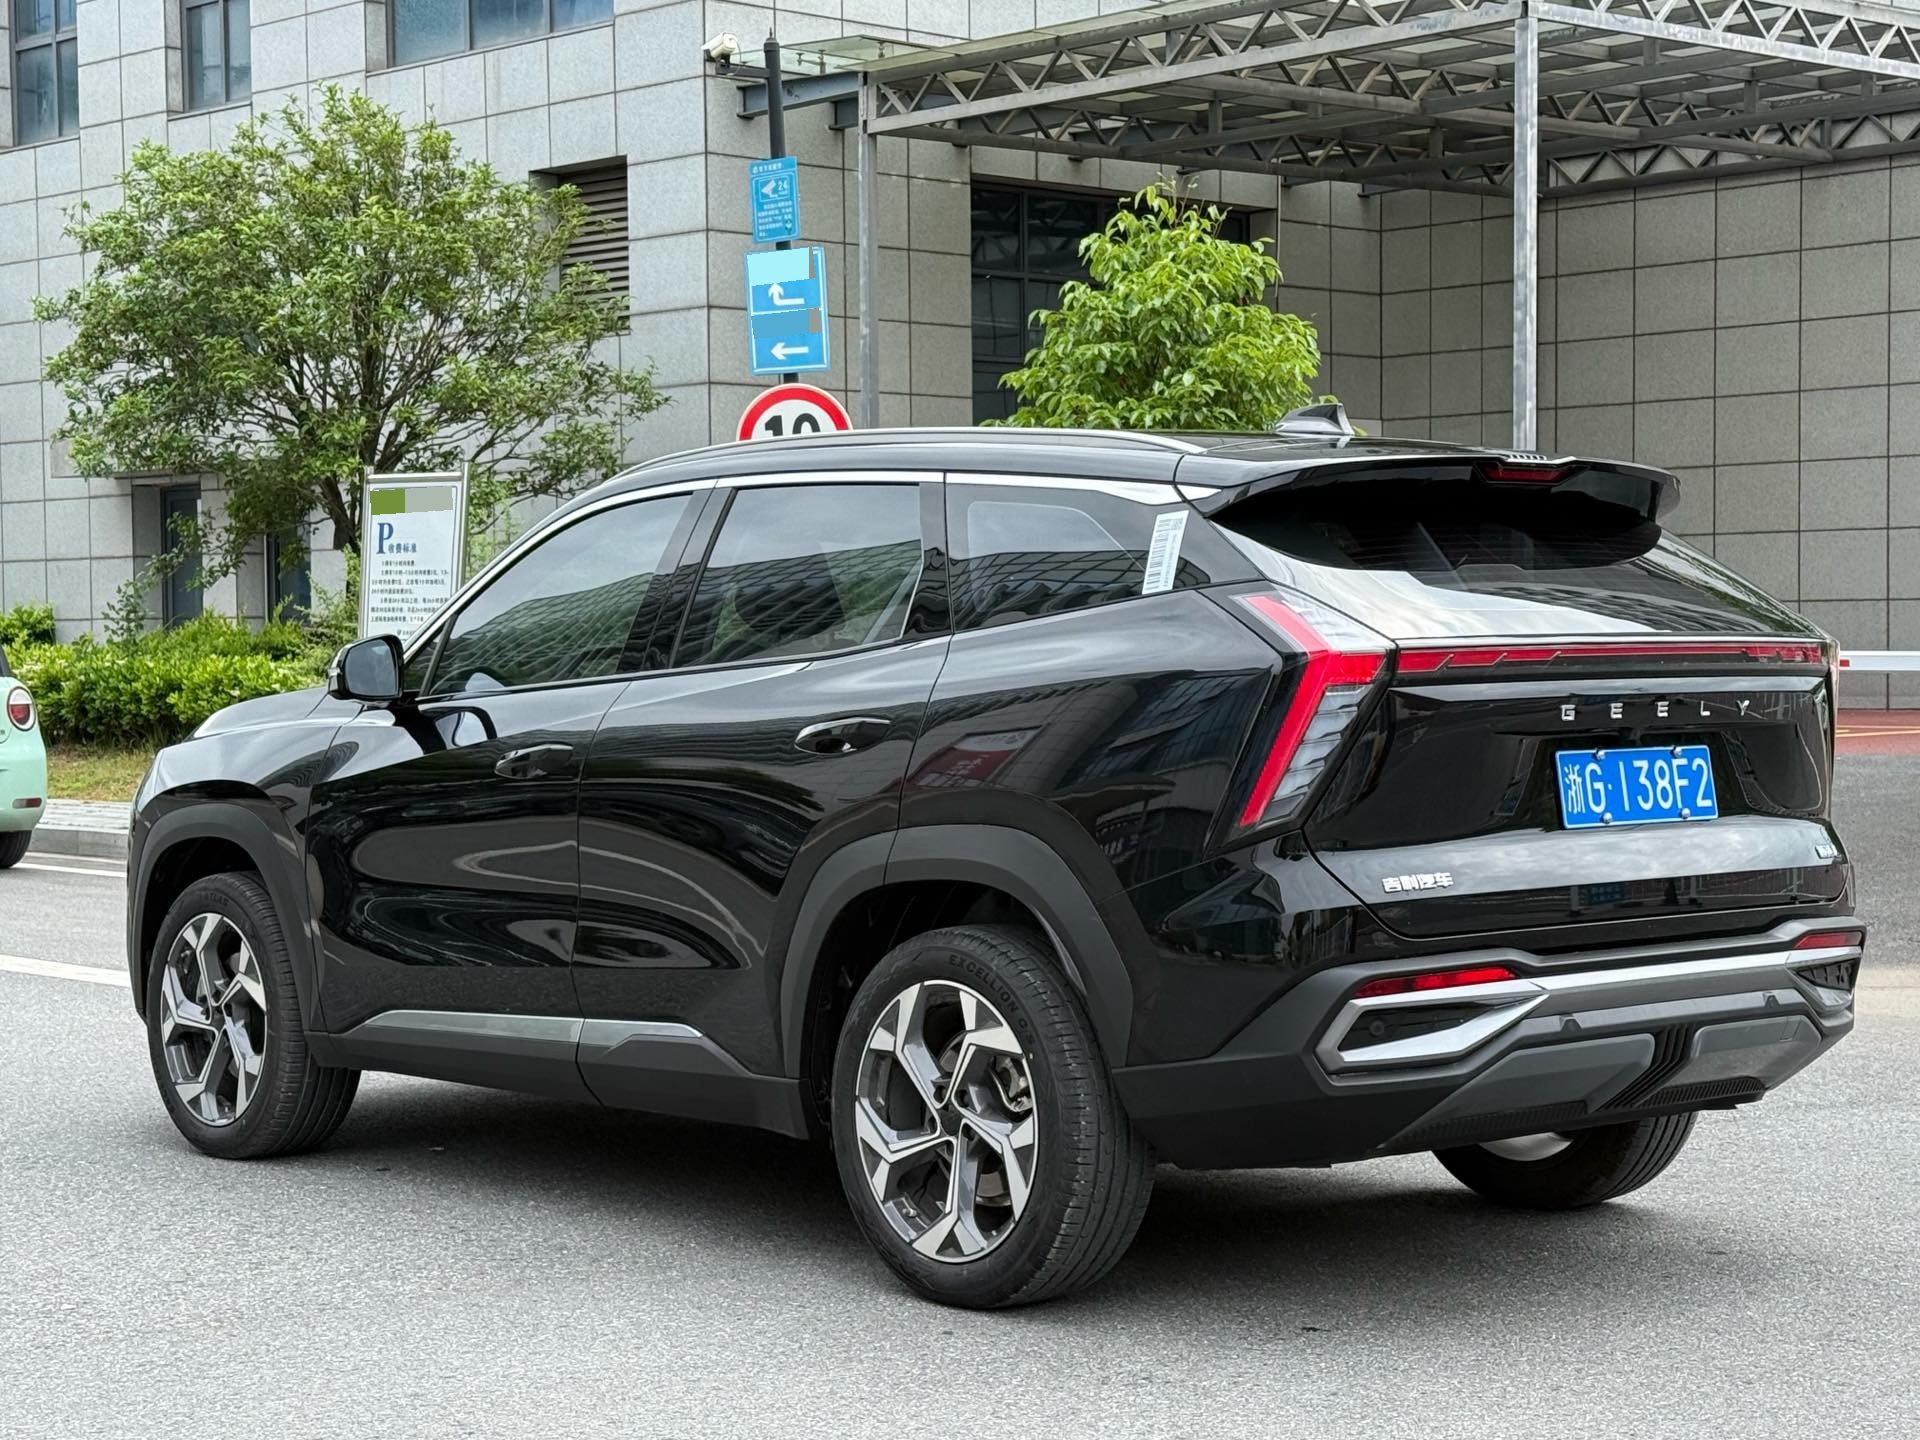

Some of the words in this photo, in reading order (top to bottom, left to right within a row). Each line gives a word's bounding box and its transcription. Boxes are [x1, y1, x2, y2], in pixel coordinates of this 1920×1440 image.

[376, 522, 394, 555] P
[1560, 700, 1750, 721] GEELY
[1382, 872, 1454, 893] 吉利汽车
[949, 954, 1019, 1013] EXCELLION
